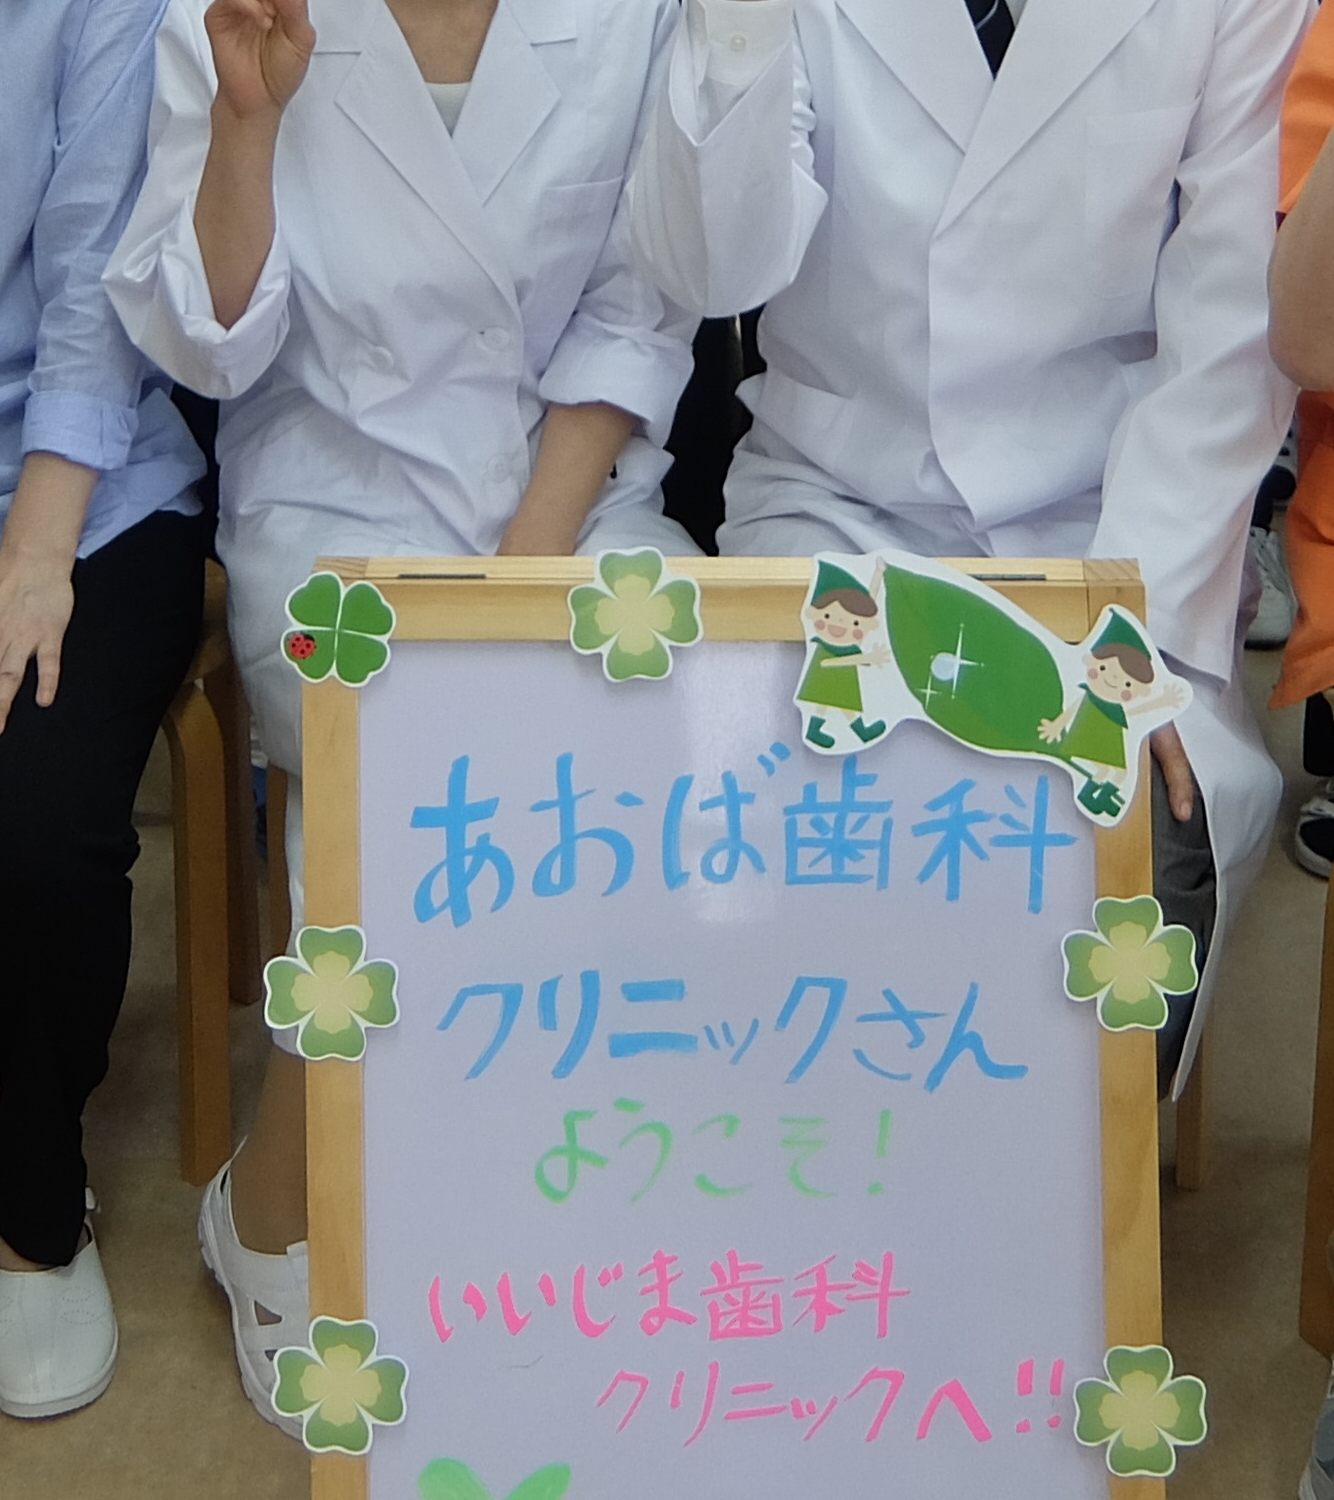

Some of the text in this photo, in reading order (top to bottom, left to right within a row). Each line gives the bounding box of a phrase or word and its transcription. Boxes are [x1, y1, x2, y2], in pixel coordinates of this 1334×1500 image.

[411, 742, 1077, 929] あおば歯科
[437, 968, 1029, 1094] クリニックさん
[533, 1098, 893, 1204] ようこそ!
[427, 1248, 911, 1344] いいじま歯科
